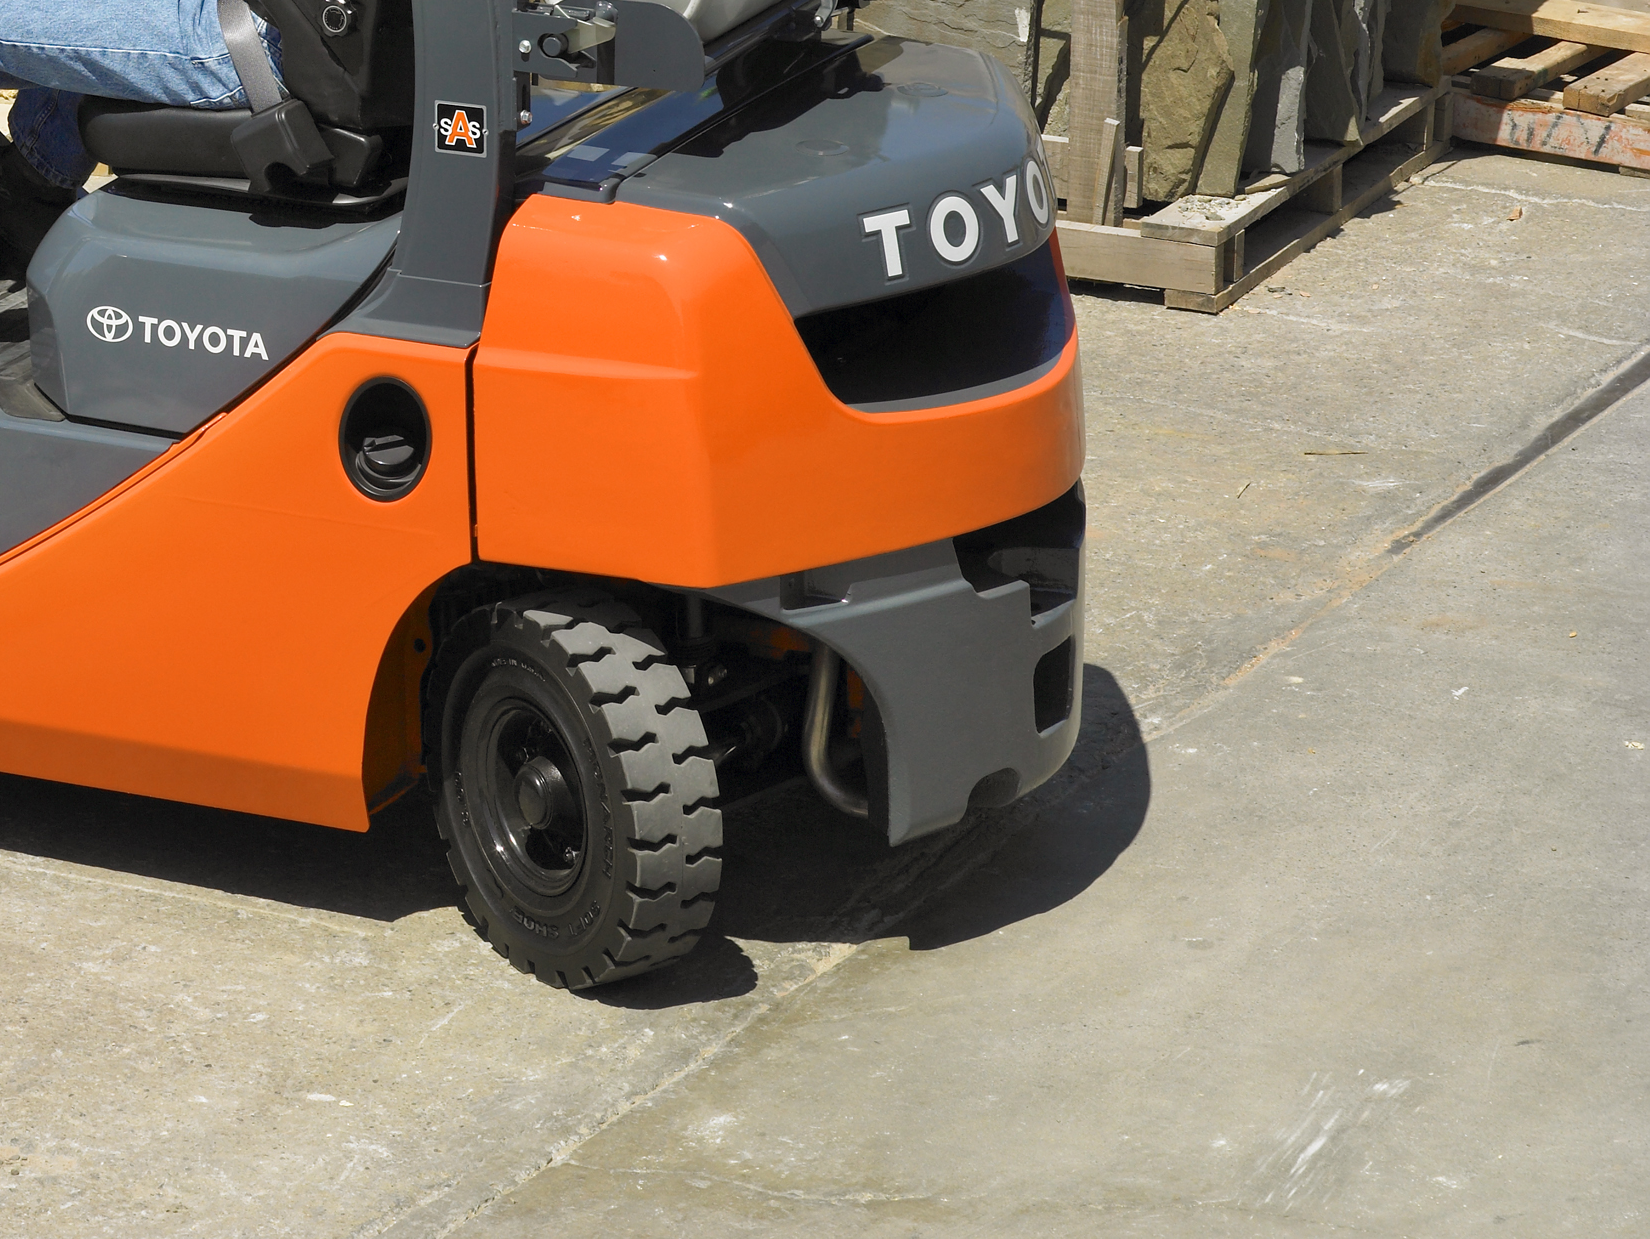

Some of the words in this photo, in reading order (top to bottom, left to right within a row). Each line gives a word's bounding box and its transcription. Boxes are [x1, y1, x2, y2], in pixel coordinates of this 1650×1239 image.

[439, 109, 481, 149] SAS
[863, 138, 1054, 278] TOYO
[138, 315, 269, 361] TOYOTA
[581, 736, 616, 881] MONARCH
[511, 904, 560, 940] SHOE
